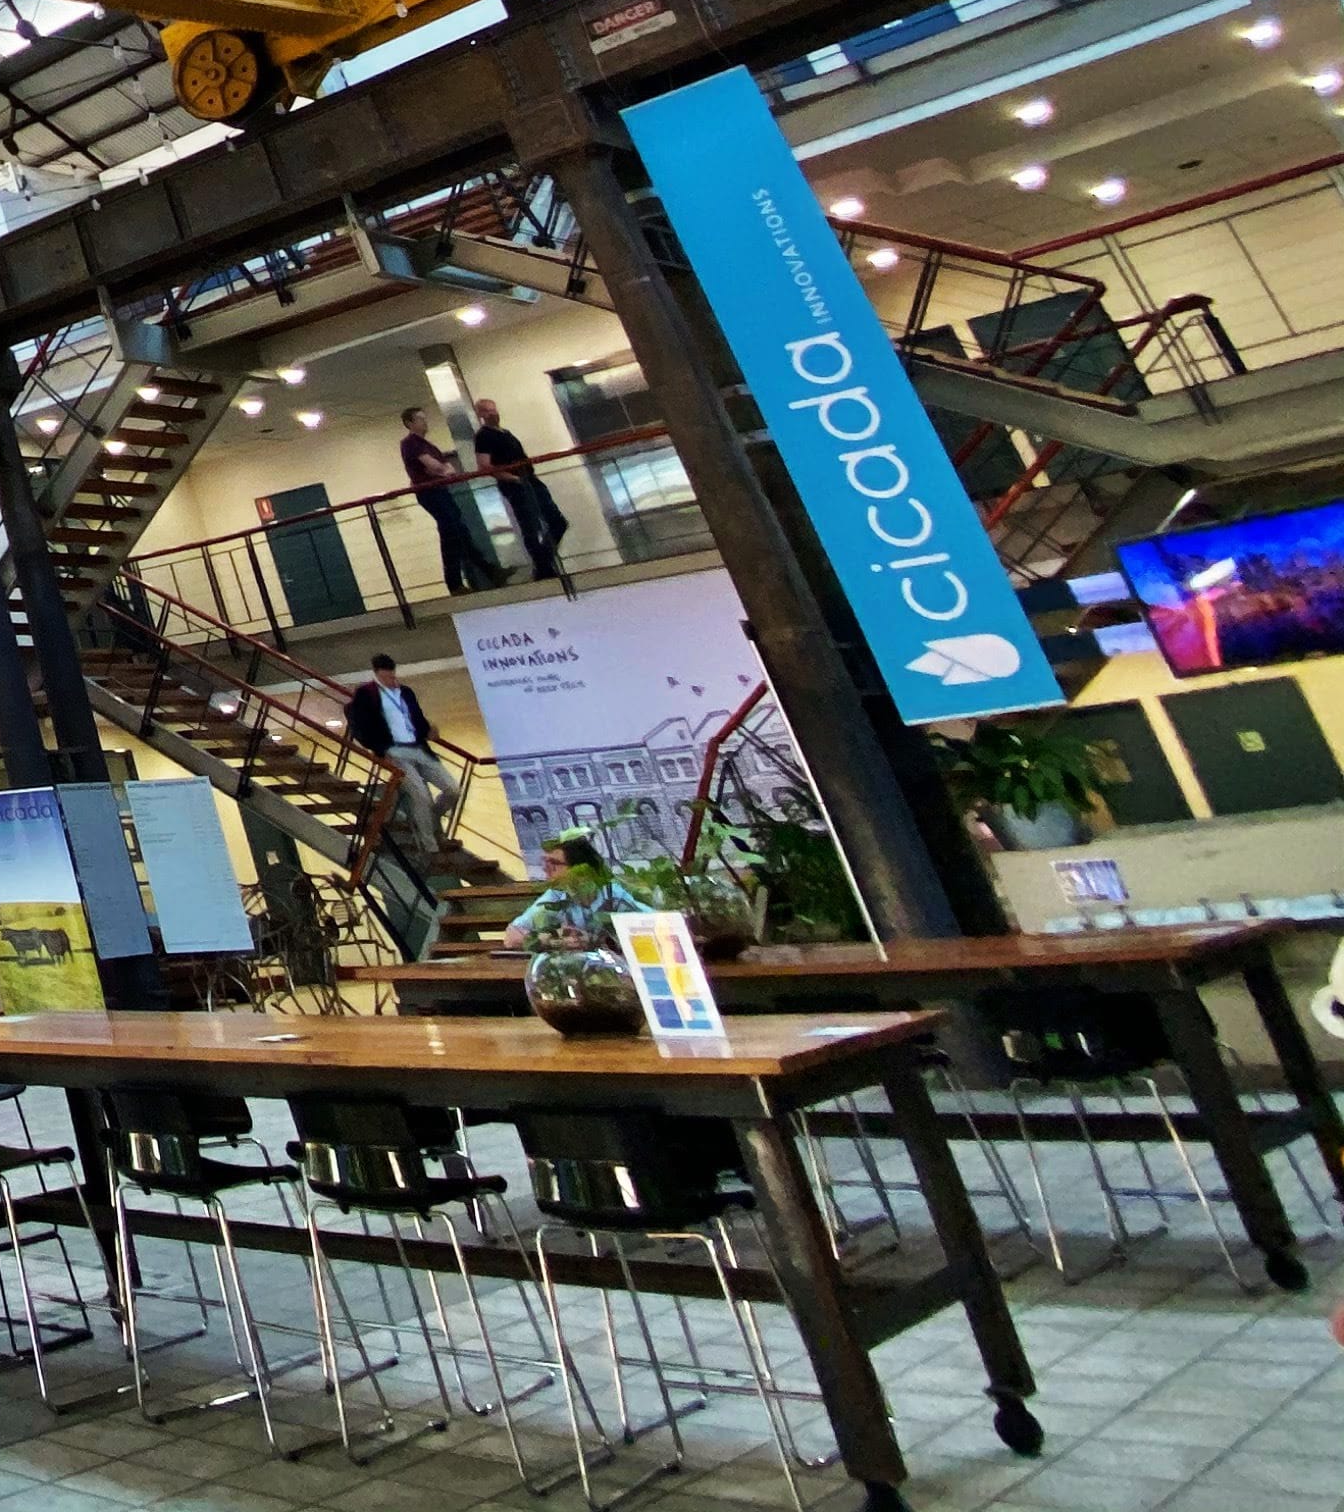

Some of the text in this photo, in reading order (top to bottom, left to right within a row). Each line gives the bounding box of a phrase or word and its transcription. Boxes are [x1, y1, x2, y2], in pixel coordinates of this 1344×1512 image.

[592, 0, 656, 35] DANGER
[751, 187, 833, 326] INNOVATIONS
[785, 331, 969, 621] cicada
[476, 631, 535, 652] CICADA
[482, 645, 580, 672] INNOVATIONS
